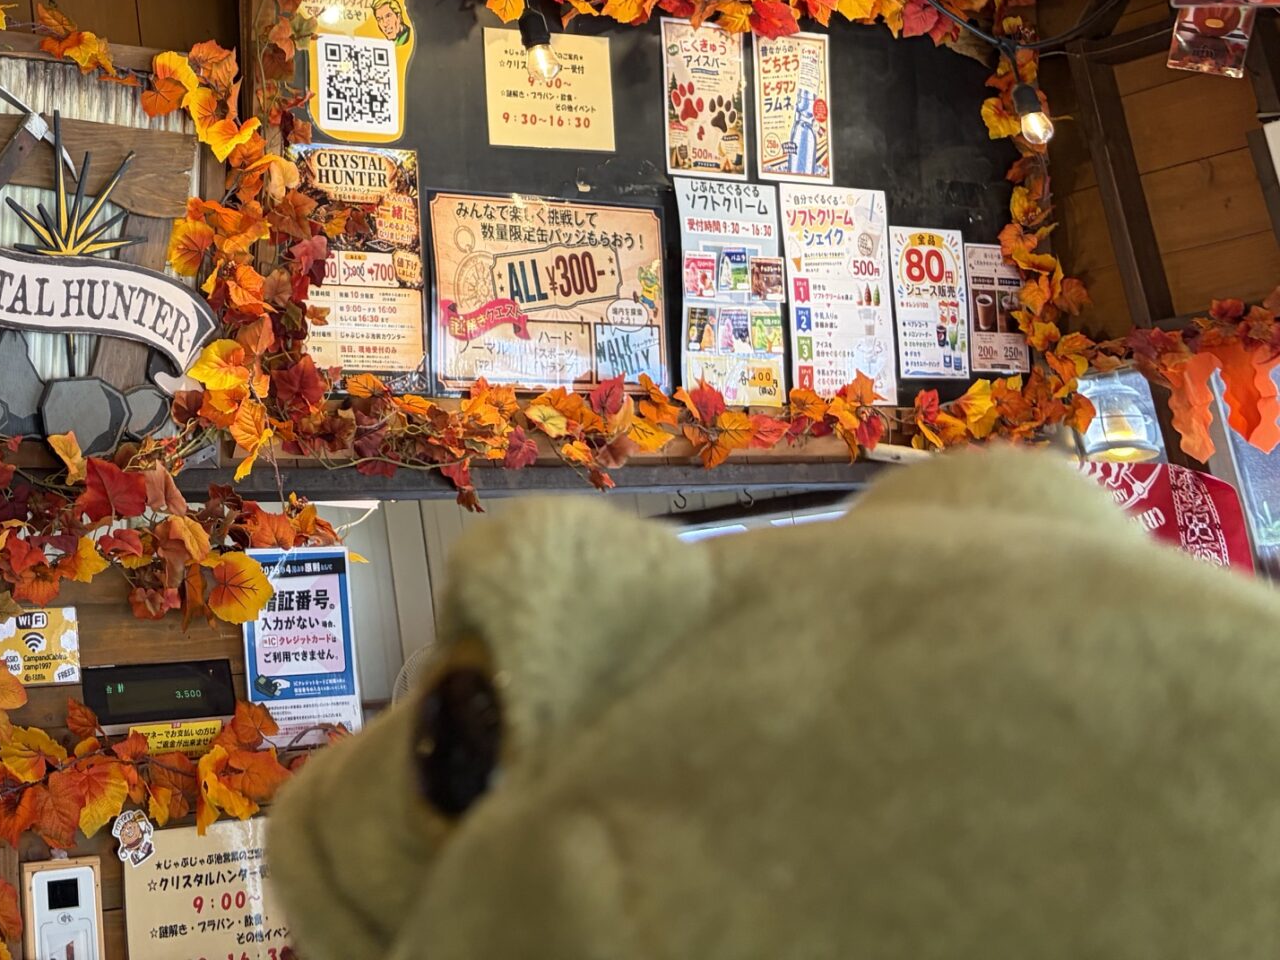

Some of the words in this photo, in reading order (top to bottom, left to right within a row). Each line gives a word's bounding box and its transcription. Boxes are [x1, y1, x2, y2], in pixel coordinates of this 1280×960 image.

[679, 38, 727, 56] にくきゅう
[683, 54, 727, 69] アイスバー
[762, 54, 800, 74] ごちそう
[317, 152, 387, 171] CRYSTAL
[317, 169, 388, 188] HUNTER
[691, 181, 760, 198] じぶんでぐるぐる
[686, 194, 768, 214] ソフトクリーム
[456, 202, 599, 227] みんなで楽しく挑戦して
[786, 209, 853, 226] ソフトクリーム
[804, 228, 843, 246] シェイク
[917, 234, 936, 246] 全品
[853, 260, 879, 277] 500円
[507, 259, 549, 304] ALL
[906, 283, 956, 298] ジュース販売
[61, 279, 191, 353] HUNTER
[538, 330, 574, 345] ハード
[597, 334, 632, 363] WALK
[24, 662, 52, 671] camp1997
